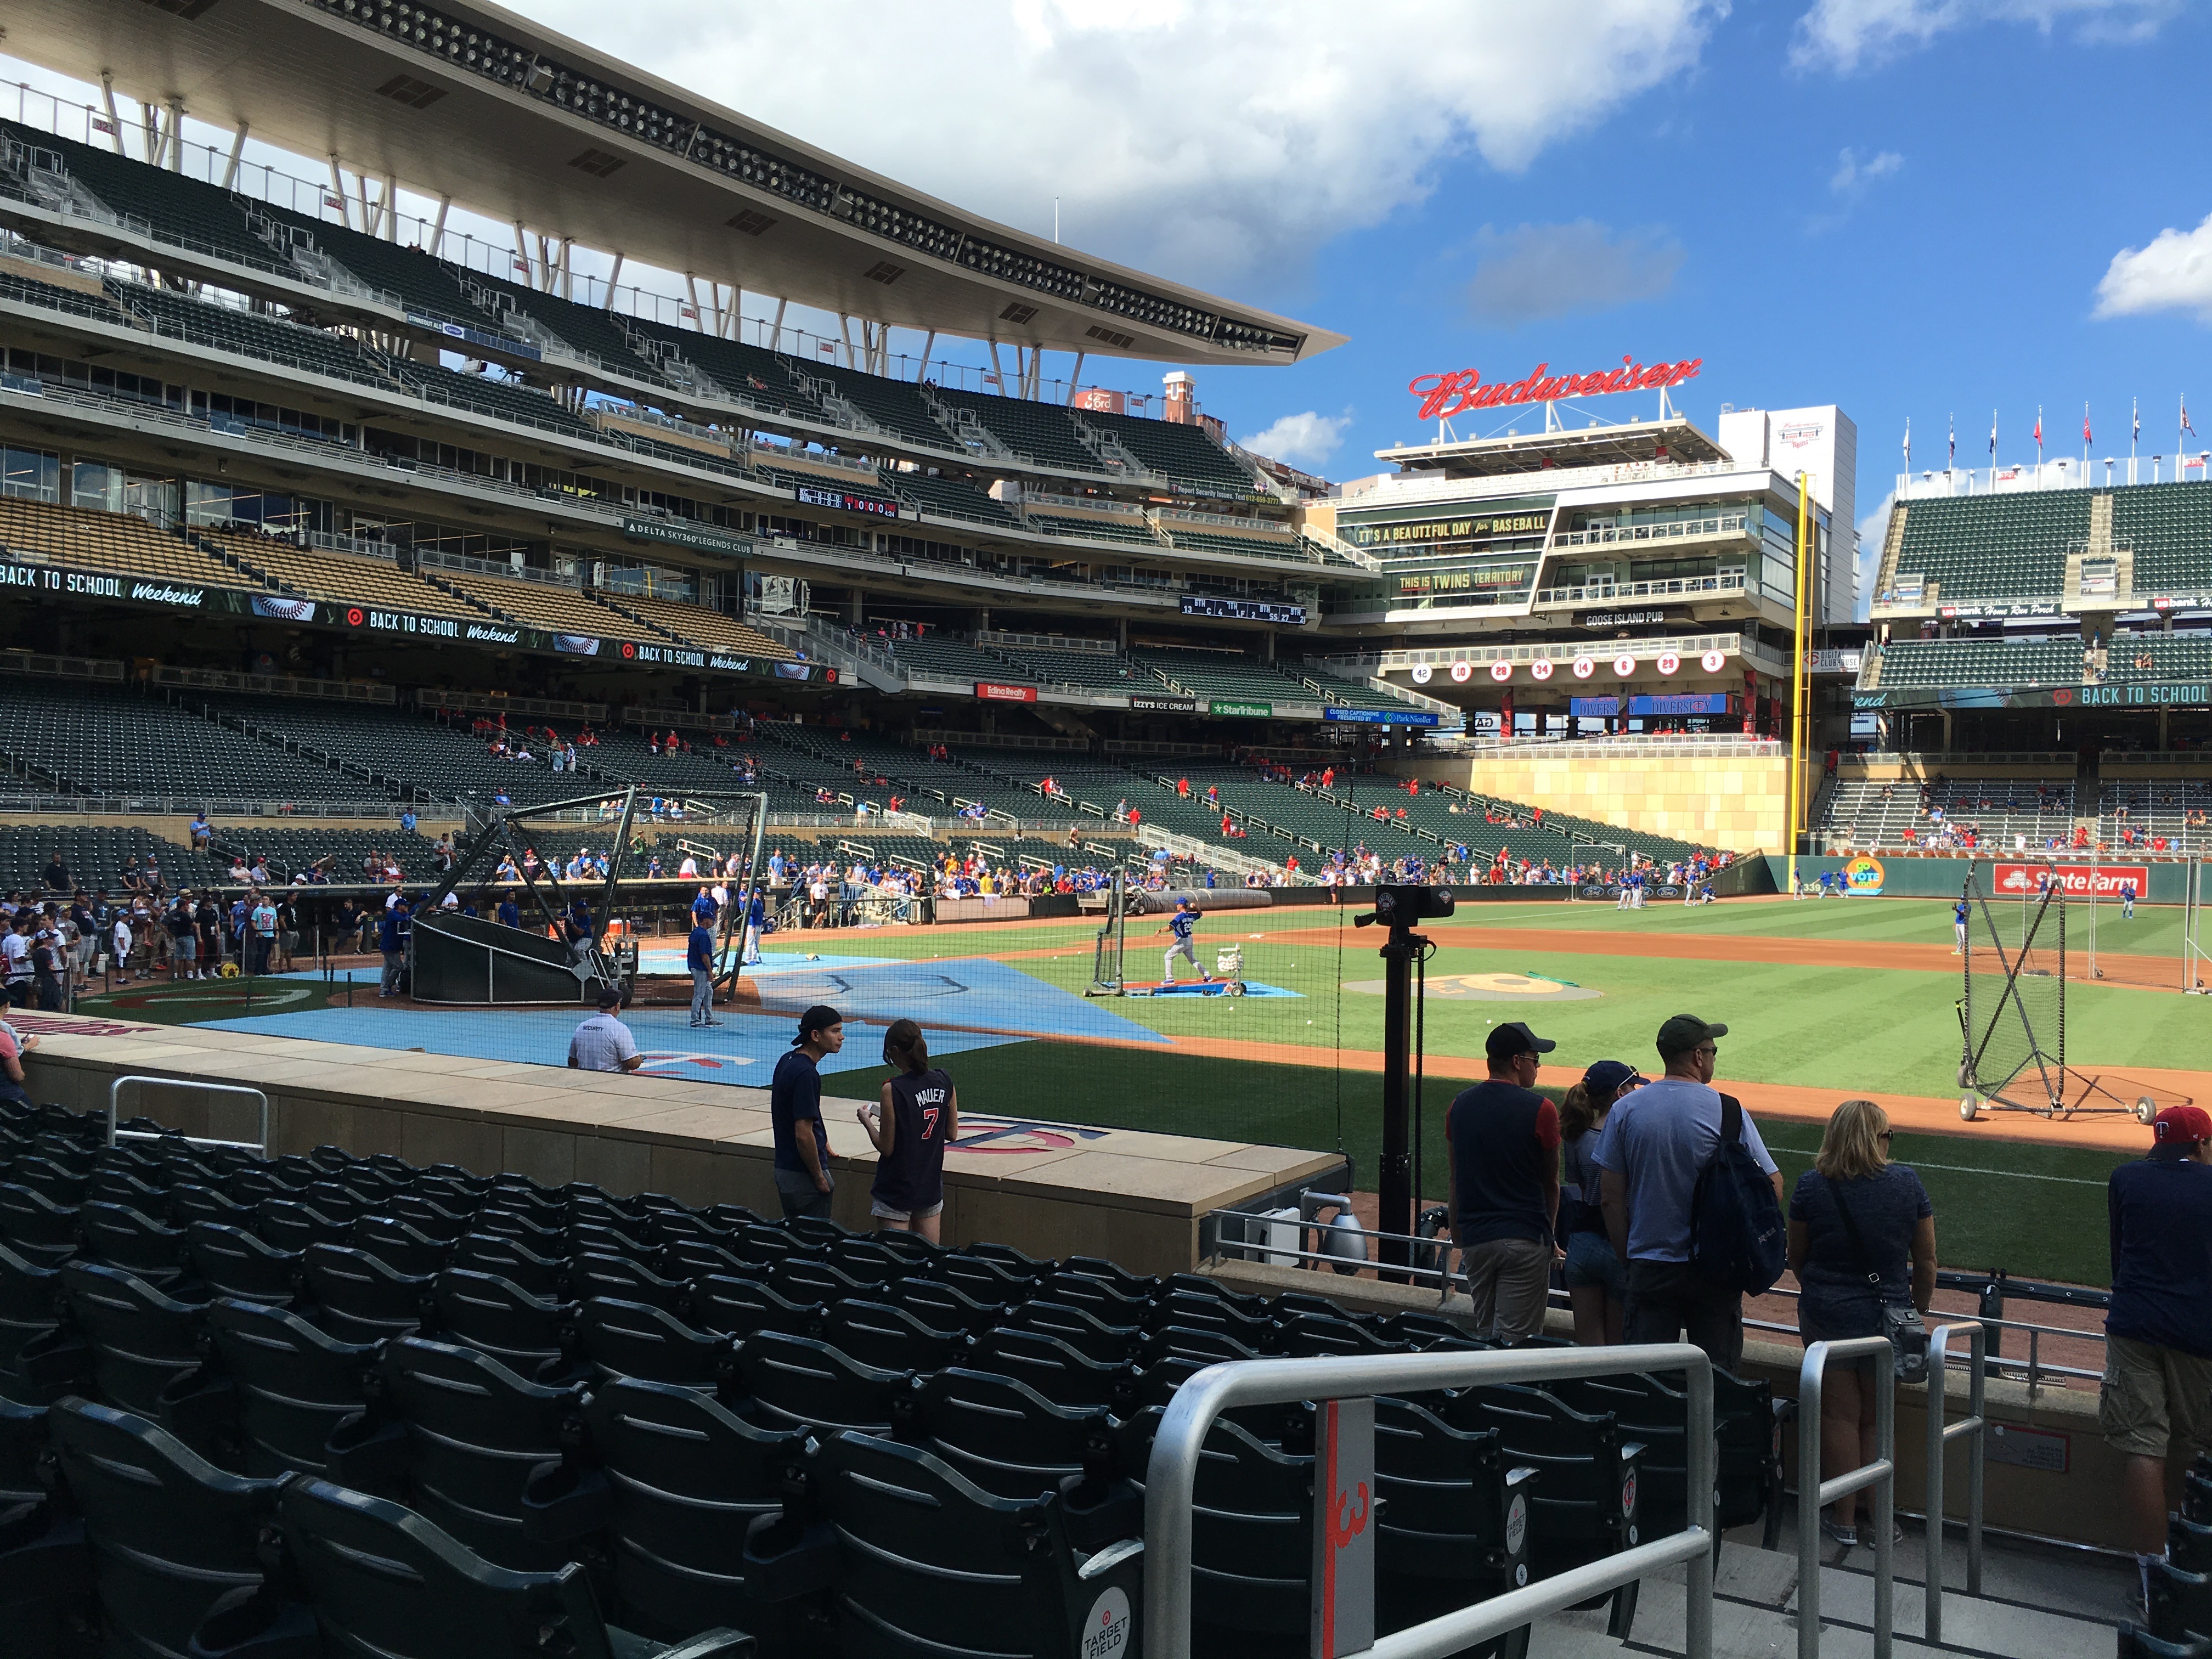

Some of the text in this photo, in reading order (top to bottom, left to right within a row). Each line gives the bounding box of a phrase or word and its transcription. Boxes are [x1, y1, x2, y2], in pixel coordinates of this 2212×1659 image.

[328, 197, 342, 208] 322
[684, 308, 696, 317] 324
[409, 314, 432, 326] STRIKEOUT
[1408, 354, 1703, 420] Budweiser
[1084, 393, 1110, 408] Ford
[1178, 486, 1195, 494] Report
[1195, 488, 1216, 498] Security
[1234, 493, 1245, 501] Text
[1358, 516, 1545, 543] IT'S A BEAUTIFUL DAY for BASEBALL
[637, 524, 665, 537] DELTA
[698, 537, 731, 550] LEGENDS
[732, 544, 751, 554] CLUB
[1400, 570, 1524, 589] THIS IS TWINS TERRITORY
[43, 569, 60, 590] TO
[67, 573, 121, 597] SCHOOL
[132, 583, 204, 606] Weekend
[1218, 608, 1223, 616] 4
[1984, 606, 2008, 617] Home
[2010, 605, 2028, 616] Run
[2030, 603, 2055, 615] Porch
[1586, 611, 1664, 627] GOOSE ISLAND PUB
[370, 611, 518, 644] BACK TO SCHOOL Weekend
[639, 646, 749, 671] BACK TO SCHOOL Weekend
[1662, 658, 1674, 669] 29
[1710, 656, 1716, 667] 3
[1820, 658, 1857, 667] CLUBHOUSE
[1496, 666, 1507, 676] 28
[1536, 664, 1548, 675] 34
[1578, 663, 1588, 673] 14
[1621, 661, 1627, 670] 6
[1417, 669, 1427, 678] 42
[1456, 667, 1465, 676] 10
[988, 686, 1005, 695] Edina
[2082, 686, 2208, 704] BACK TO SCHOOL
[1169, 703, 1194, 711] CREAM
[1409, 715, 1431, 724] Nicollet
[1856, 862, 1871, 872] go
[1849, 872, 1880, 881] VOTE
[1587, 888, 1600, 896] Ford
[1661, 888, 1674, 896] Ford
[1803, 883, 1821, 892] 339
[915, 1088, 945, 1107] MAUER
[922, 1108, 939, 1139] 7
[1507, 1514, 1525, 1533] TARGET
[1509, 1524, 1522, 1540] FIELD
[1084, 1616, 1127, 1651] TARGET
[1090, 1634, 1121, 1659] FIELD
